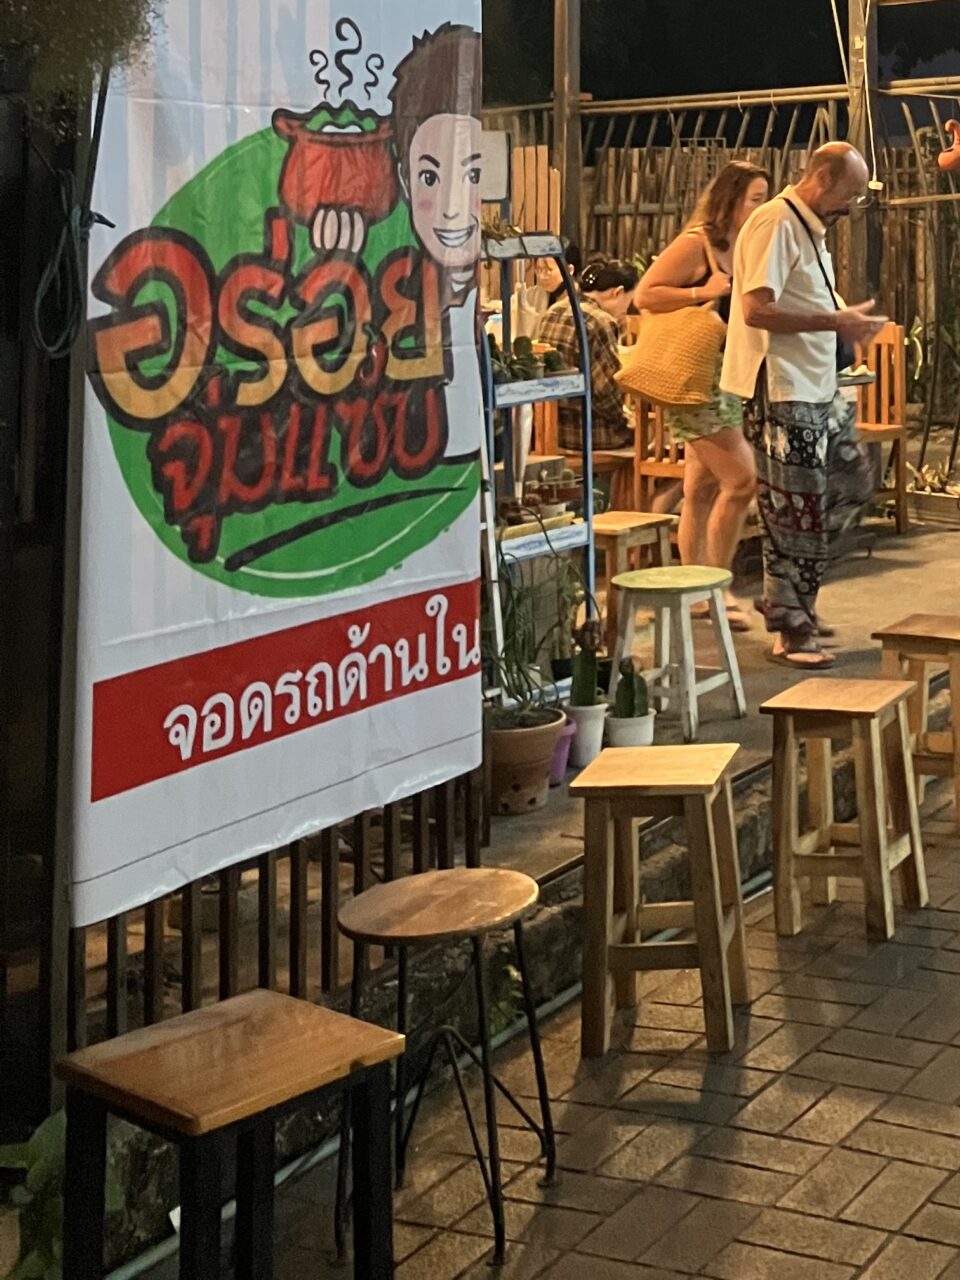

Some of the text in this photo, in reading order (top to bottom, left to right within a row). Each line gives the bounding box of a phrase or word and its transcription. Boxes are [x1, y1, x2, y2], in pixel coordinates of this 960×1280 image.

[88, 209, 451, 426] อร่อย
[163, 594, 481, 761] จอดรถด้านใน
